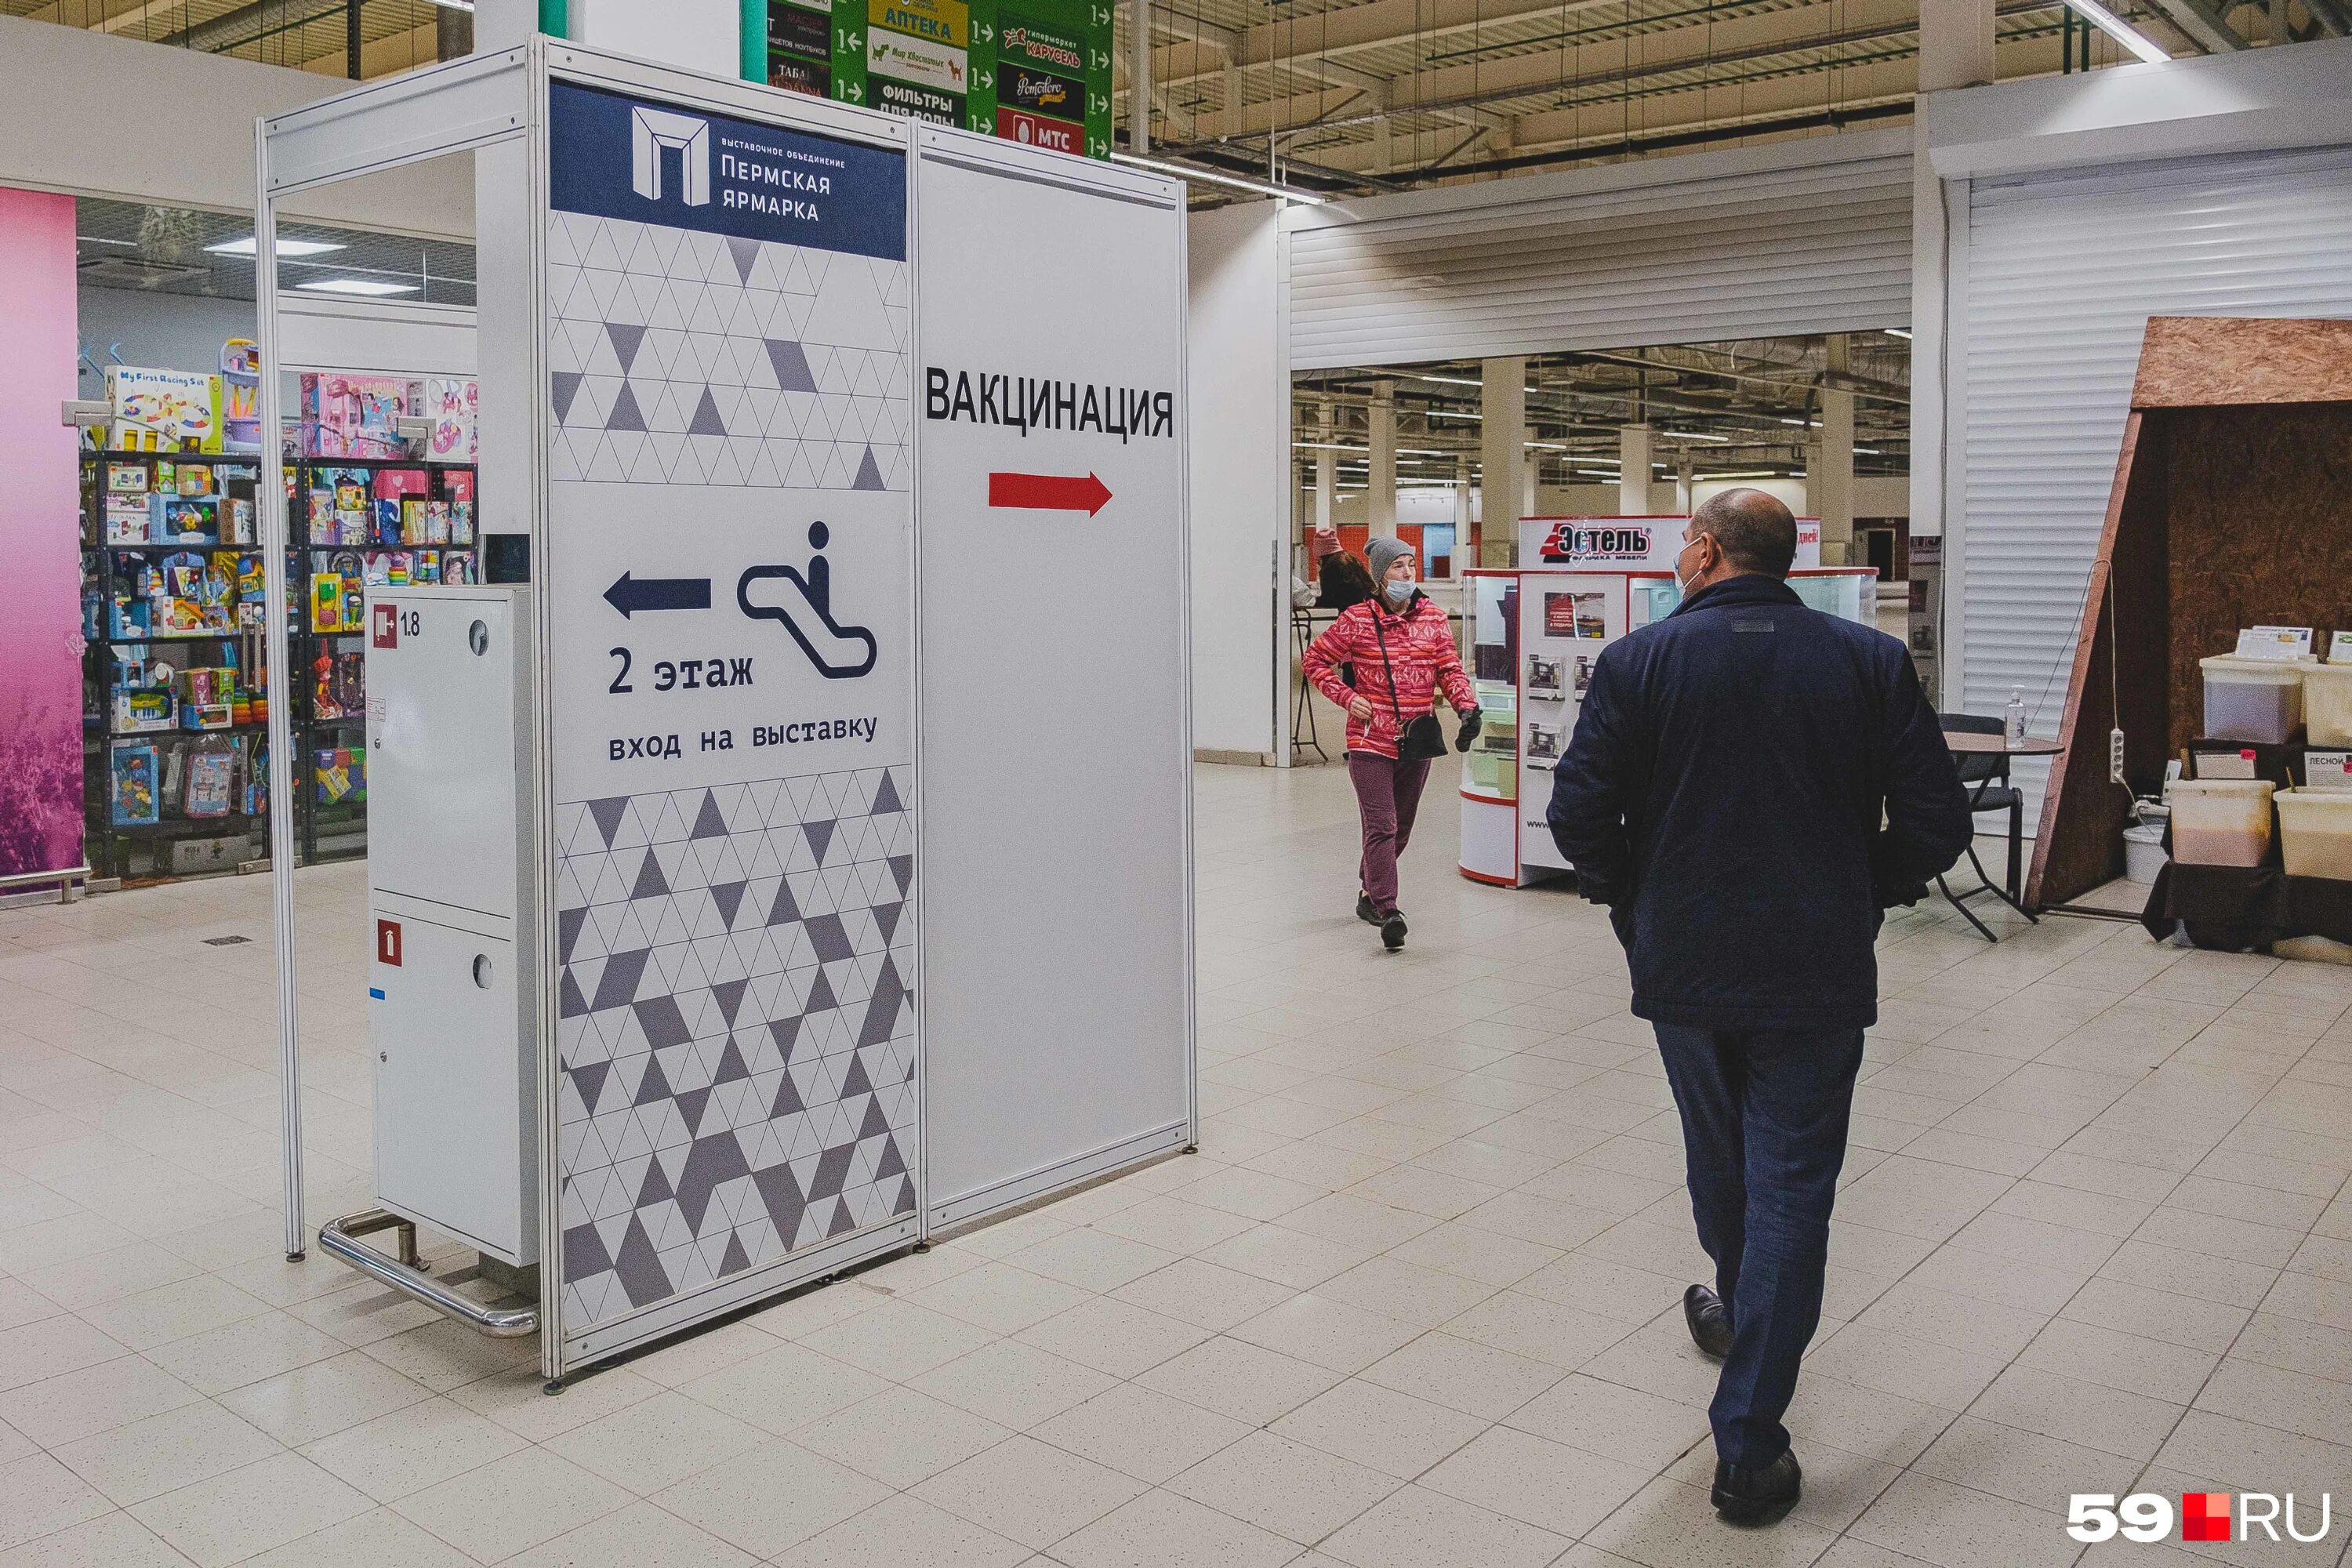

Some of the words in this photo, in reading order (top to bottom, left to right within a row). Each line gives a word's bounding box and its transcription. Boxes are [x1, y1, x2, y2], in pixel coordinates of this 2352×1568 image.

[884, 7, 953, 39] АПТЕКА
[891, 47, 906, 60] Мир
[1027, 29, 1077, 49] гипермаркет
[1026, 41, 1080, 68] КАРУСЕЛЬ
[883, 85, 953, 112] ФИЛЬТРЫ
[721, 137, 783, 157] ВЫСТАВОЧНОЕ
[786, 151, 846, 169] ОБЪЕДИНЕНИЕ
[1038, 128, 1070, 150] МТС
[721, 154, 830, 194] ПЕРМСКАЯ
[723, 189, 819, 222] ЯРМАРКА
[120, 371, 135, 383] My
[136, 372, 158, 382] First
[926, 366, 1173, 445] ВАКЦИНАЦИЯ
[401, 611, 420, 637] 1.8
[608, 646, 633, 695] 2
[653, 657, 754, 692] этаж
[608, 733, 682, 761] вход
[700, 728, 734, 753] на
[752, 716, 878, 747] выставку
